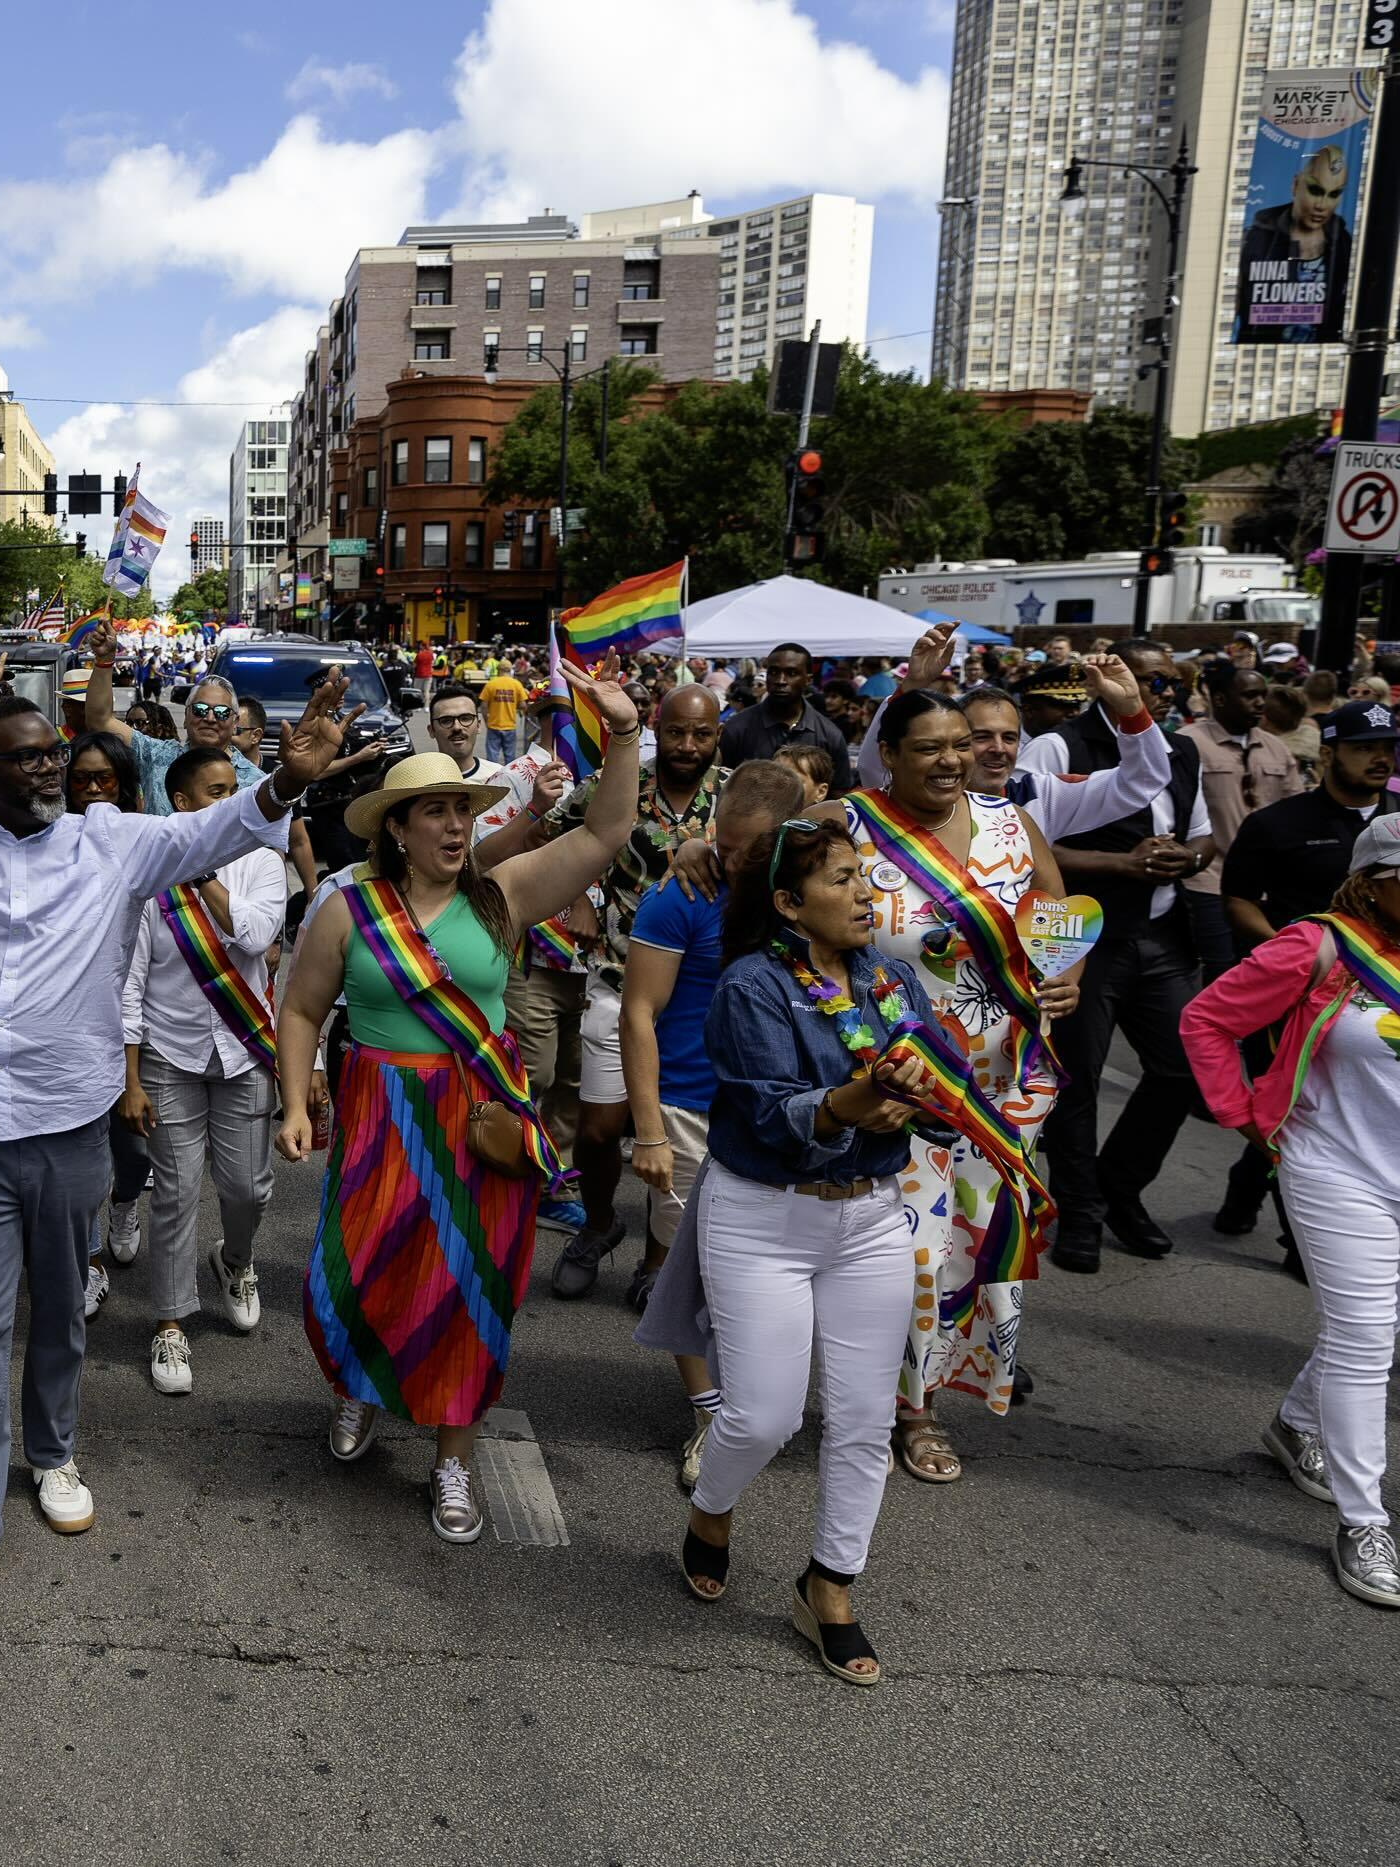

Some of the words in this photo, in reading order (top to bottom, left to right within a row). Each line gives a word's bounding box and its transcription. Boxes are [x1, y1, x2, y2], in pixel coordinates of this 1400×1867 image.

[1273, 91, 1350, 104] MARKET
[1274, 104, 1334, 117] DAYS
[1274, 117, 1319, 125] CHICAGO
[1249, 261, 1289, 281] NINA
[1252, 282, 1327, 303] FLOWERS
[1344, 451, 1400, 470] TRUCKS
[1220, 568, 1253, 578] POLICE
[921, 584, 960, 595] CHICAGO
[963, 582, 997, 593] POLICE
[1032, 897, 1068, 912] home
[1050, 914, 1084, 939] all
